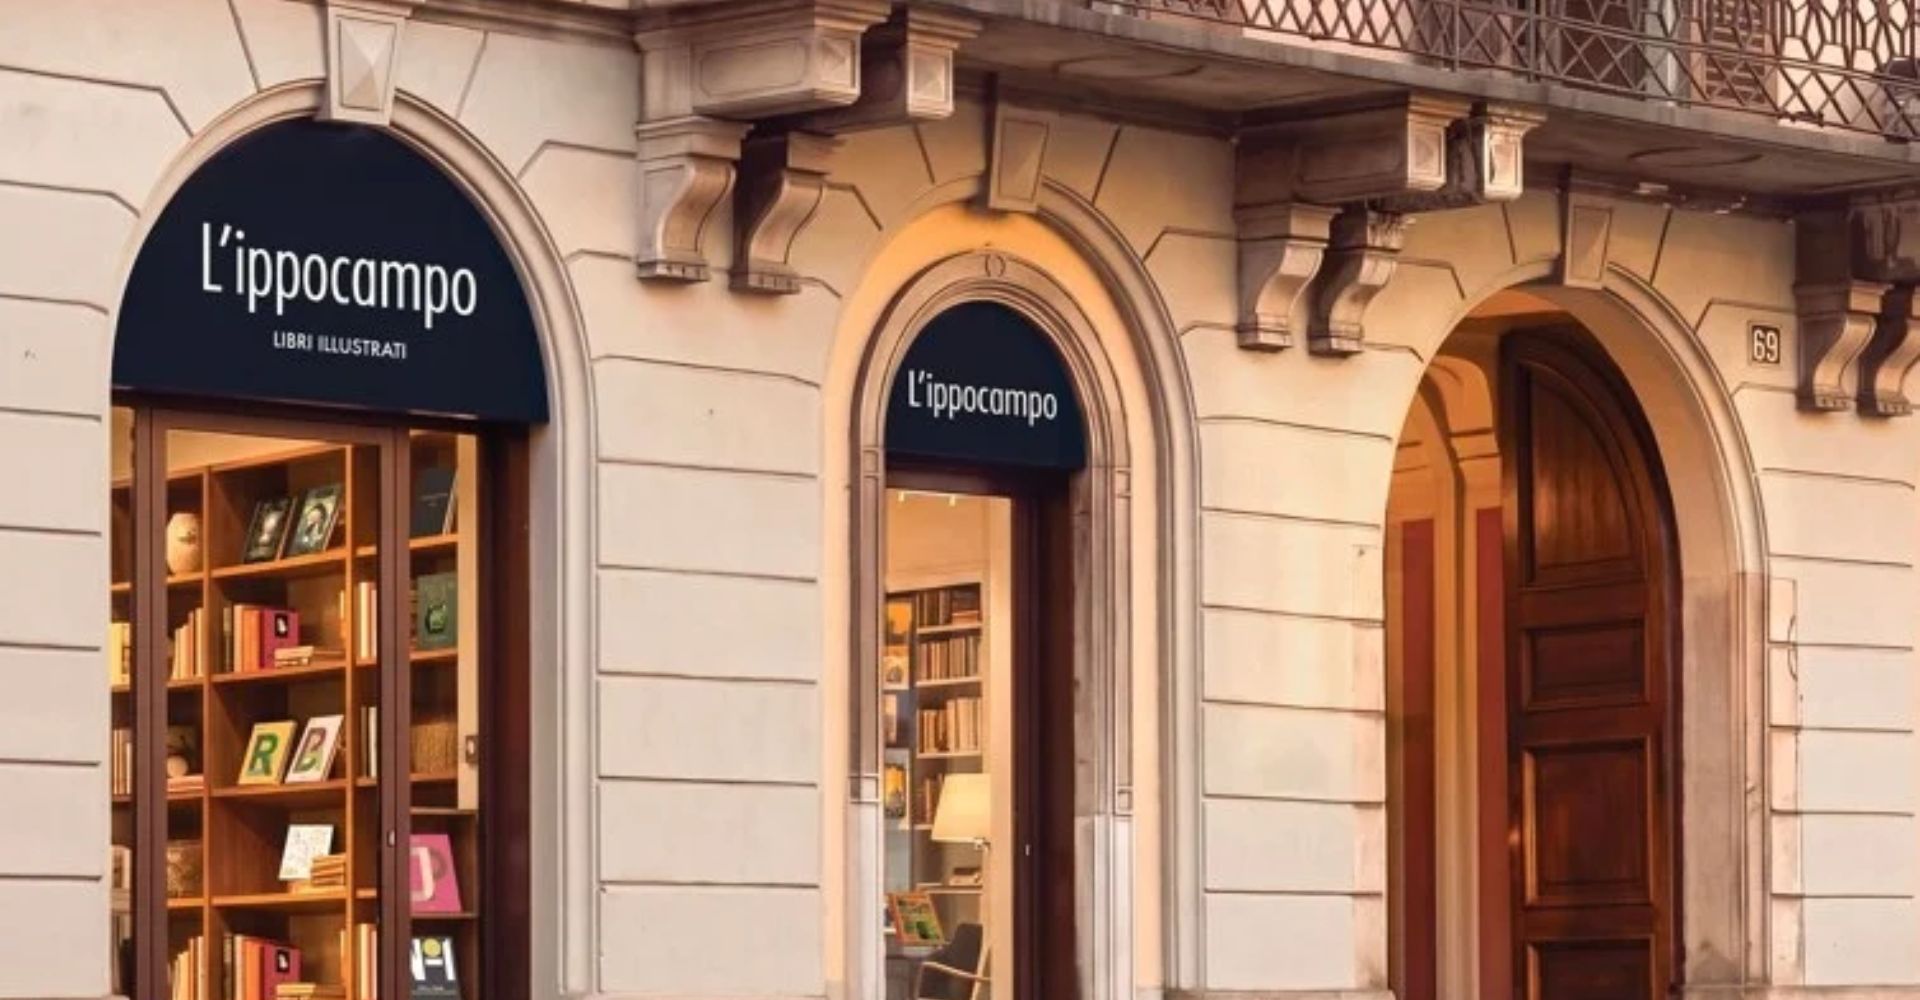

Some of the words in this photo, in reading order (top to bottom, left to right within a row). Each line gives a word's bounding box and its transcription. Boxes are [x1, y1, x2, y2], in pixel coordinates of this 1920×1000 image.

[202, 222, 478, 329] L'ippocampo
[274, 331, 313, 350] LIBRI
[318, 335, 406, 359] ILLUSTRATI
[1754, 329, 1778, 362] 69
[908, 370, 1058, 427] L'ippocampo
